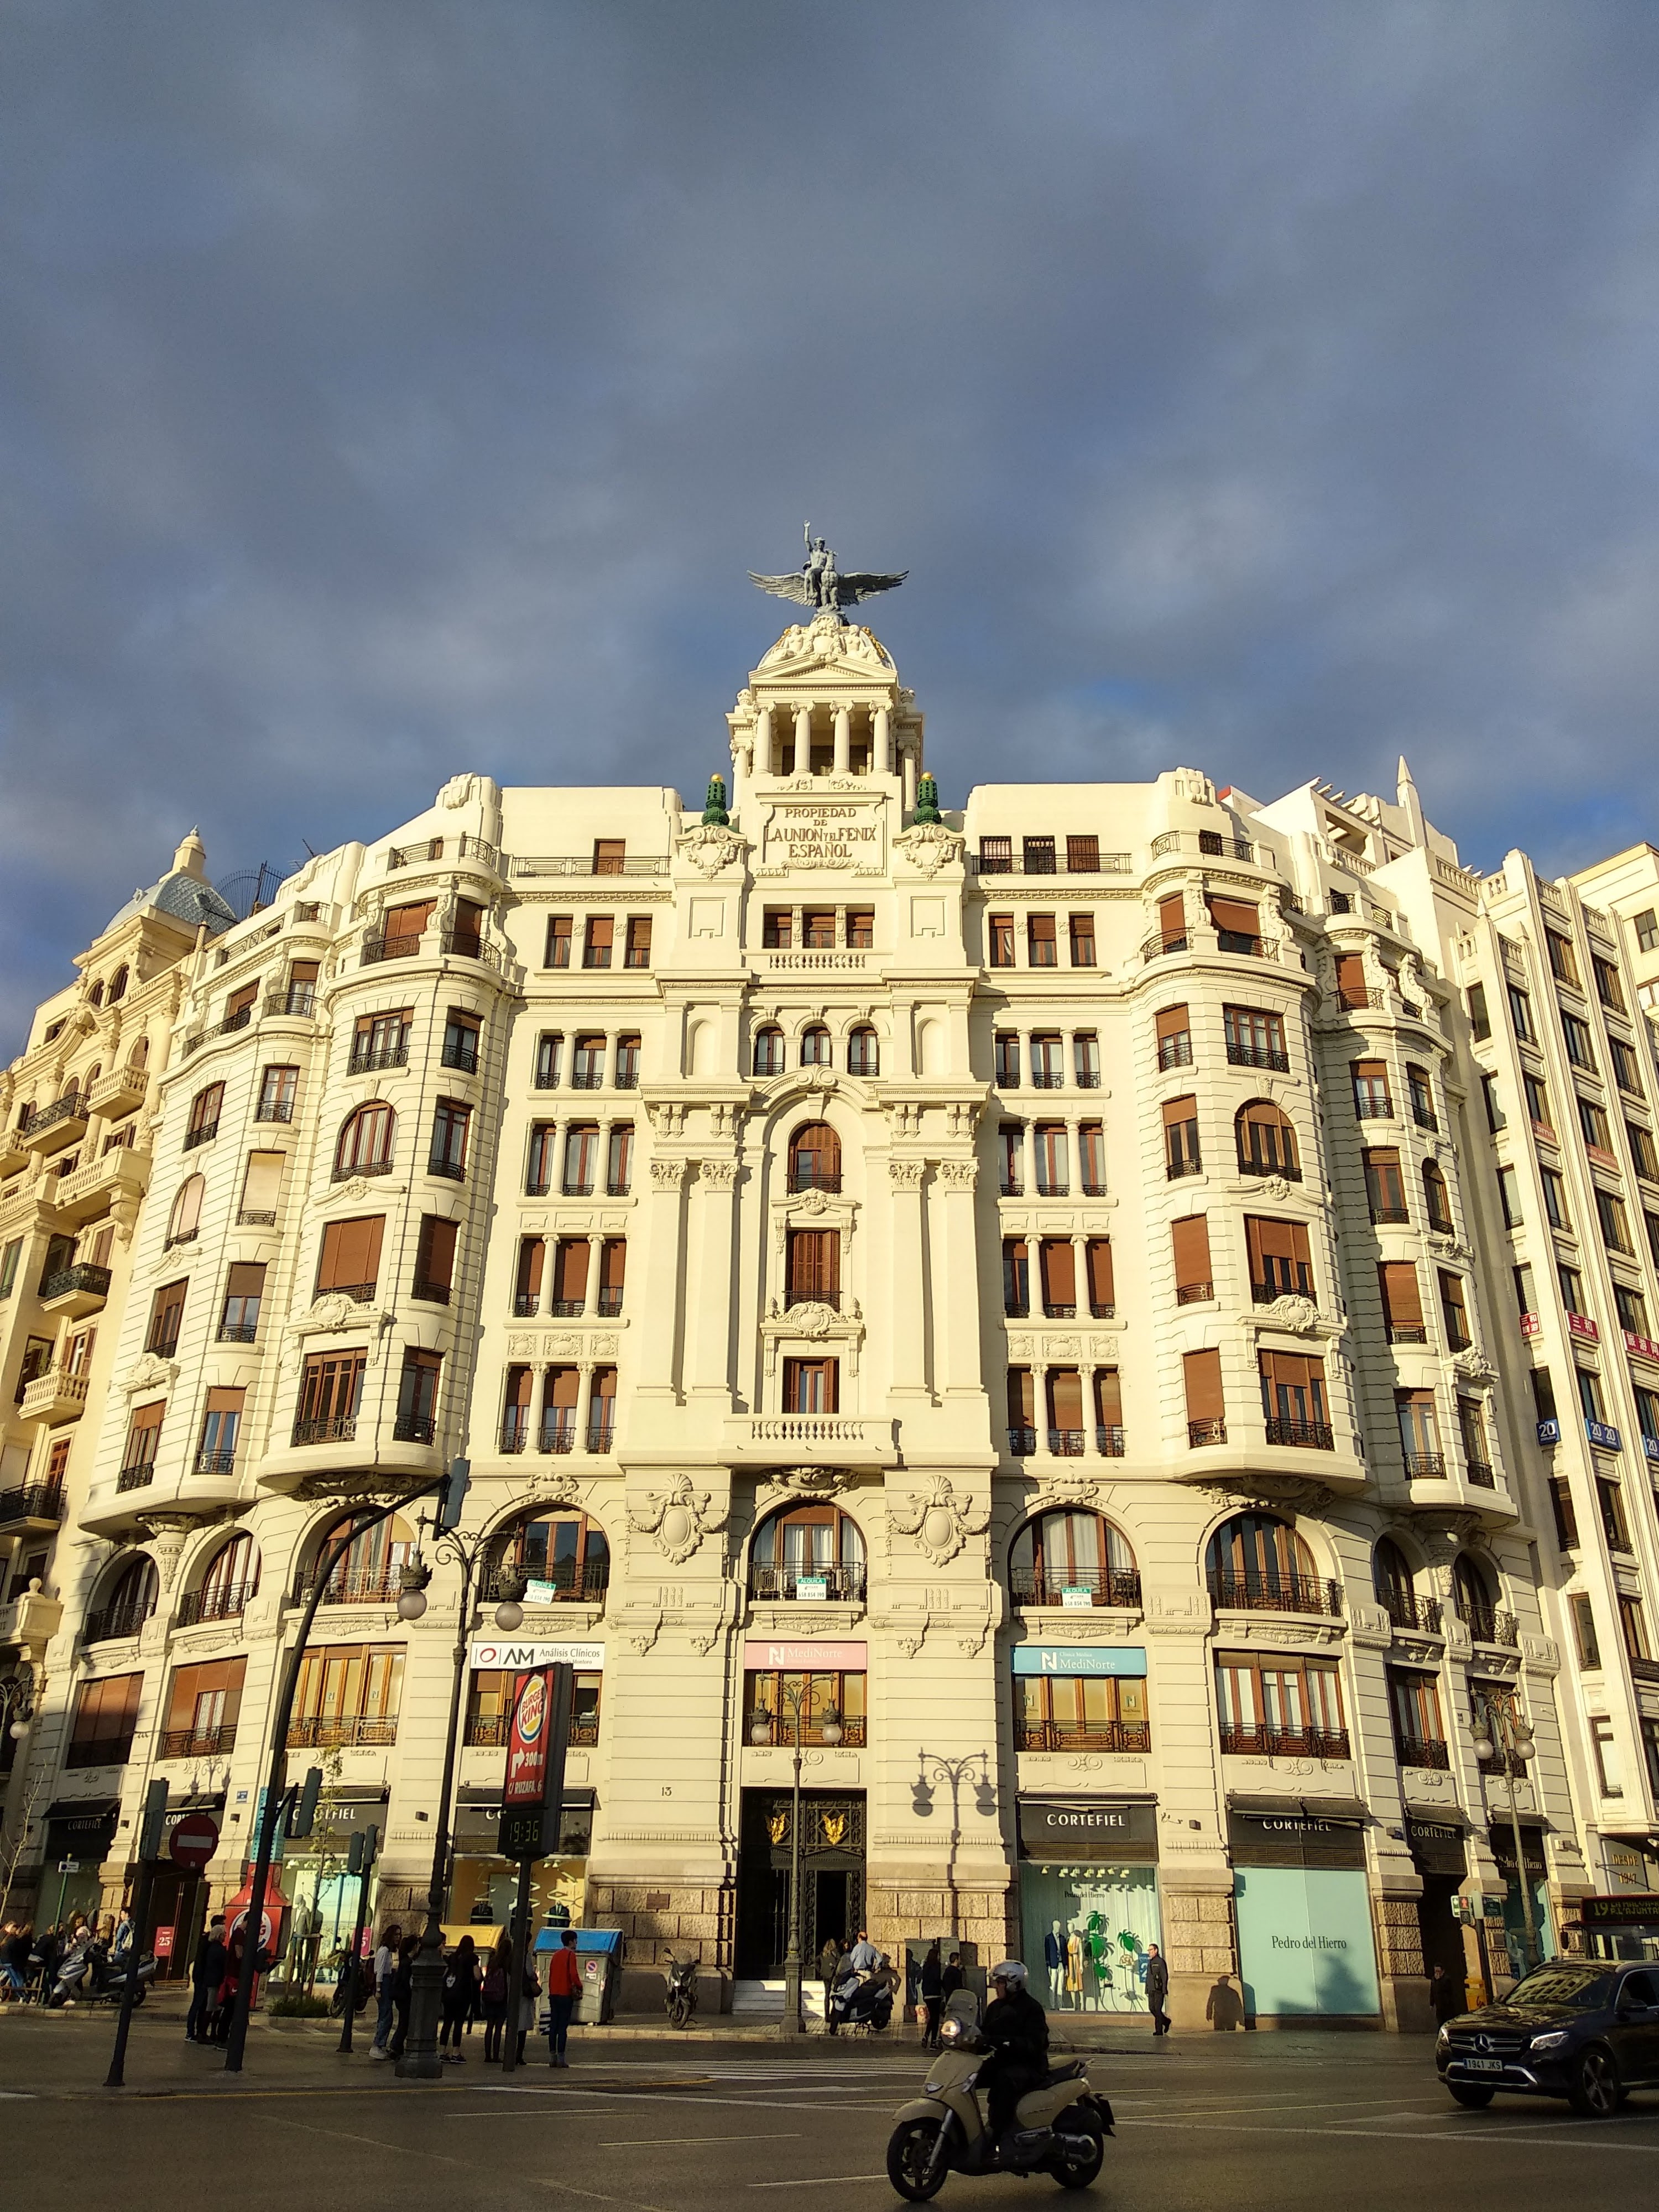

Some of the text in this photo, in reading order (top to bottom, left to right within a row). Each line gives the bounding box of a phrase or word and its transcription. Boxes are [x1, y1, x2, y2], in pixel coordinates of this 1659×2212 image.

[784, 808, 857, 818] PROPIEDAD
[765, 827, 783, 842] LA
[784, 828, 822, 842] UNION
[829, 832, 837, 841] EL
[838, 827, 877, 841] FENIX
[788, 842, 852, 858] ESPAÑOL
[1572, 1314, 1593, 1333] 三和
[1538, 1422, 1556, 1437] 20
[1590, 1422, 1602, 1437] 20
[1604, 1427, 1616, 1442] 20
[1646, 1438, 1658, 1453] 20
[539, 1647, 600, 1657] Análisis Clínicos
[787, 1647, 843, 1659] MediNorte
[1060, 1659, 1115, 1670] MediNorte
[521, 1687, 544, 1713] BURGER
[521, 1698, 544, 1729] KING
[524, 1751, 544, 1767] 300m
[536, 1780, 542, 1792] 6
[661, 1786, 672, 1797] 13
[292, 1806, 356, 1820] CEFIEL
[67, 1818, 101, 1830] CORTEFIEL
[1046, 1814, 1126, 1827] CORTEFIEL
[1262, 1817, 1332, 1832] CORTEFIEL
[509, 1820, 539, 1843] 19:36
[1411, 1825, 1457, 1839] CORTEFIEL
[1612, 1854, 1639, 1867] DESDE
[1593, 1902, 1609, 1916] 19
[1271, 1936, 1347, 1949] Pedro del Hierro
[1468, 2060, 1501, 2069] 1941 JKS
